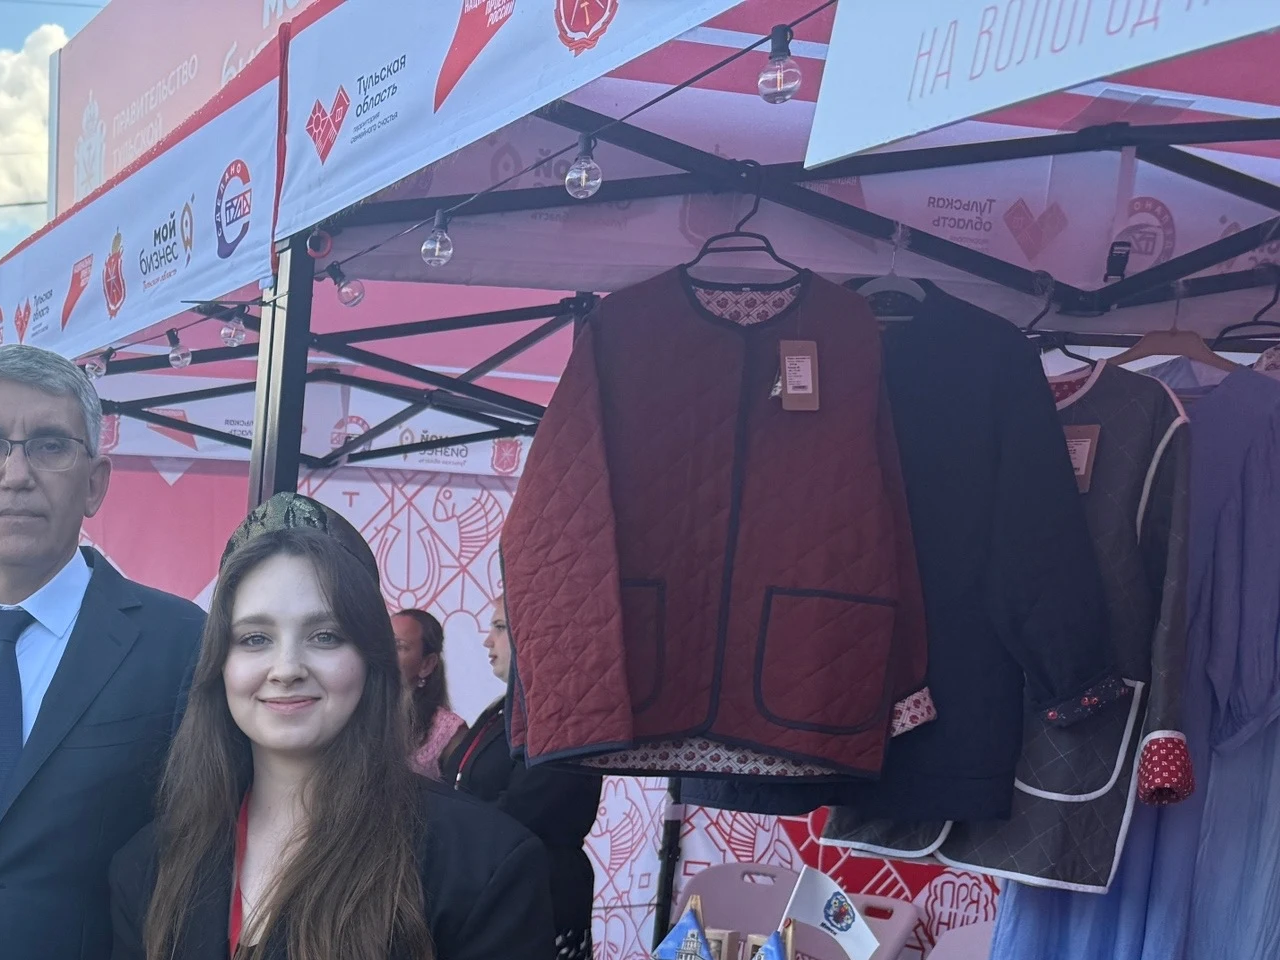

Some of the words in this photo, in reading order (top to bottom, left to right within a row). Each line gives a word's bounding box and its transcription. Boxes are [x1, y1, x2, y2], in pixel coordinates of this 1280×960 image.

[356, 53, 407, 96] Тульская
[907, 19, 958, 102] НА
[113, 54, 198, 138] ПРАВИТЕЛЬСТВО
[355, 81, 399, 118] область
[153, 211, 177, 247] мой
[139, 242, 180, 276] бизнес
[940, 880, 983, 914] ПРЯ
